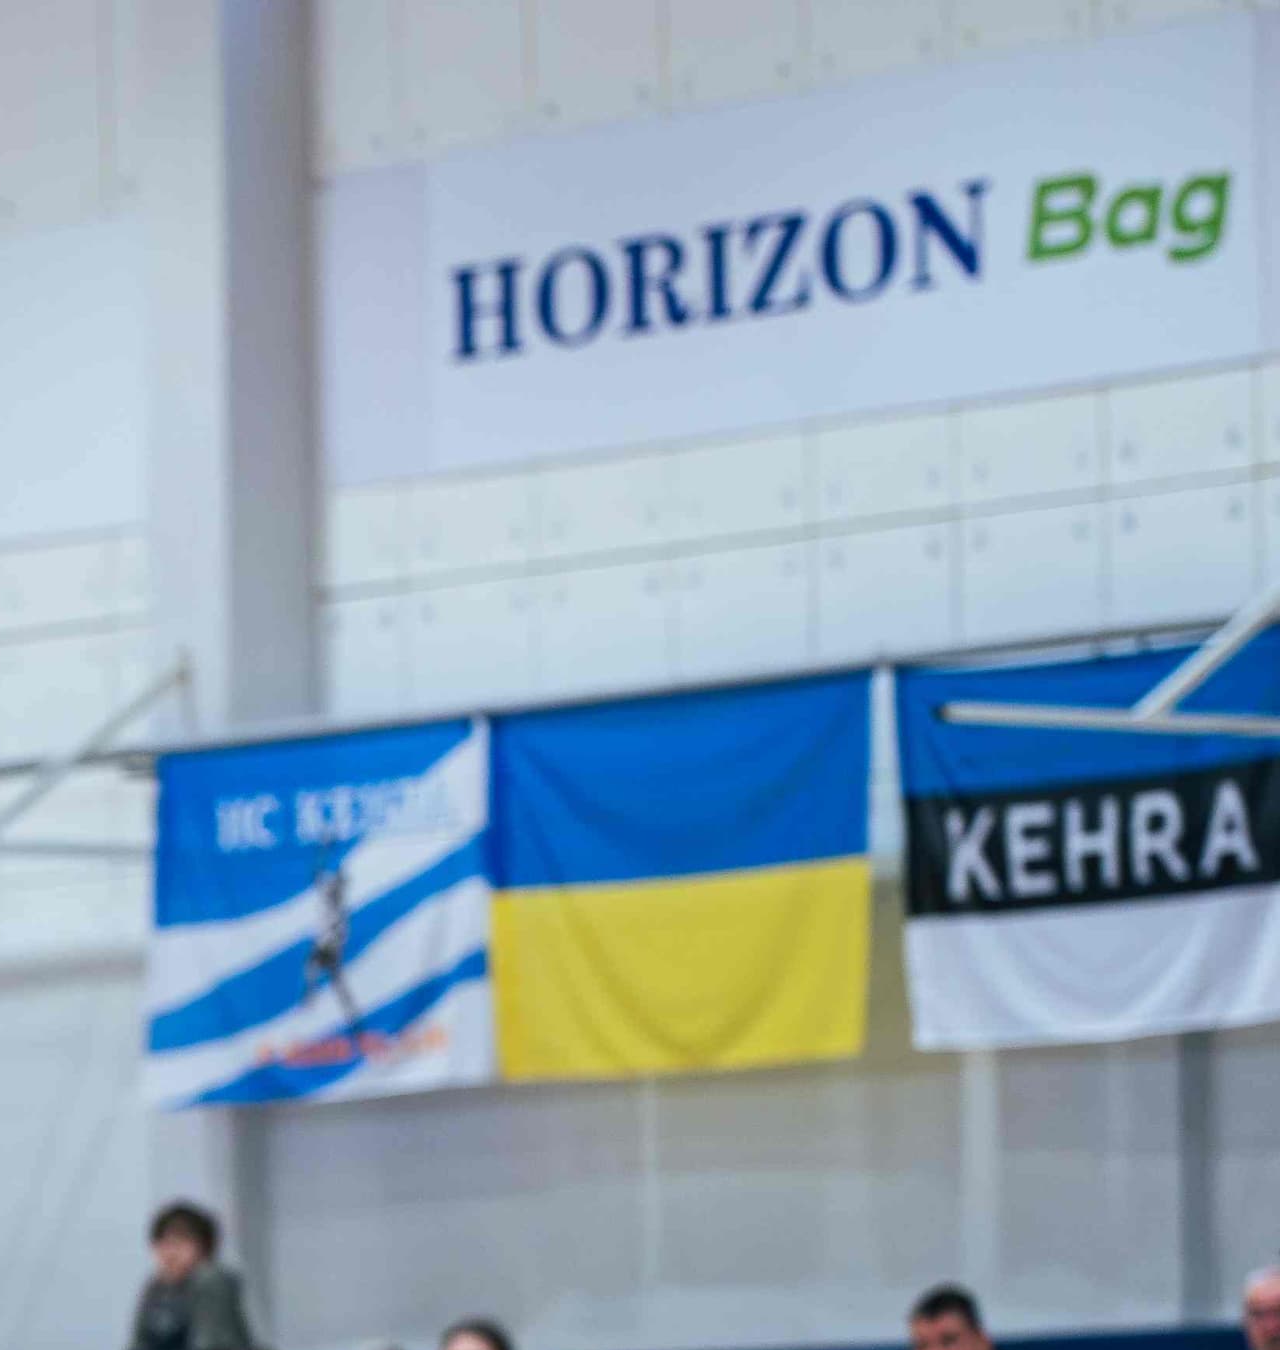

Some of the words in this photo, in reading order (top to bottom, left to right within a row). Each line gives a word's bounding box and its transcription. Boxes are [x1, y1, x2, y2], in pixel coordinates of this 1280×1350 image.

[451, 179, 990, 361] HORIZON
[1026, 170, 1231, 265] Bag
[945, 779, 1258, 900] KEHRA
